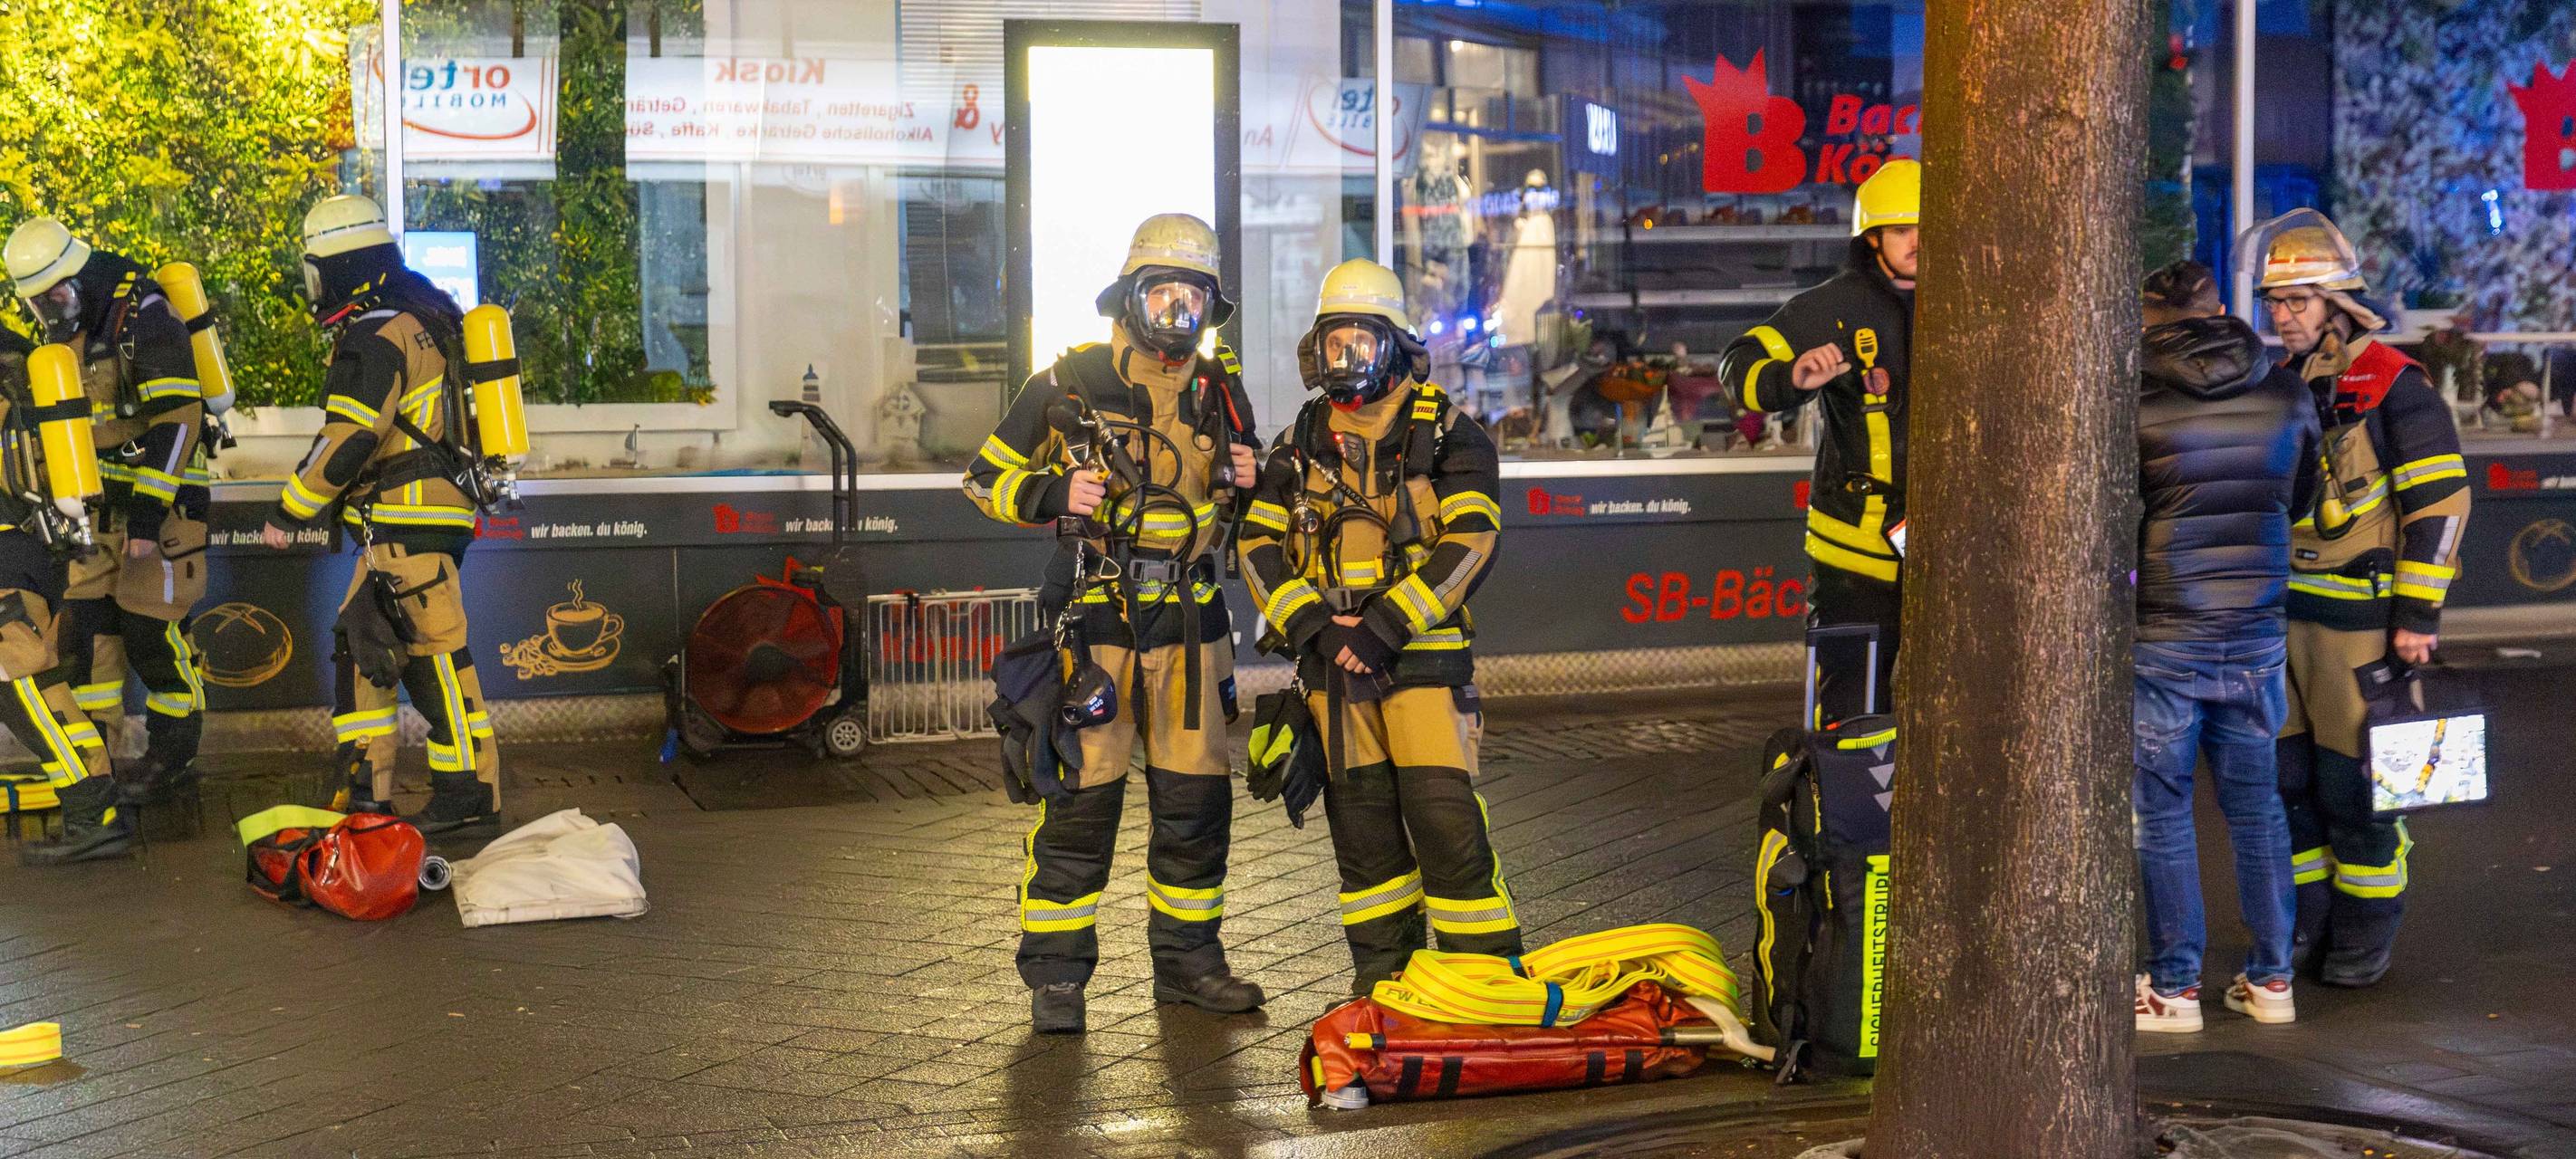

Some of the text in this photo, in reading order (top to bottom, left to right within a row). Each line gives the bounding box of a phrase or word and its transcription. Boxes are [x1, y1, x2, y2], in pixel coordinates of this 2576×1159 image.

[1825, 93, 1922, 135] Bac
[1814, 142, 1913, 185] Kö
[1590, 500, 1608, 515] wir
[1608, 500, 1645, 515] backen.
[1646, 499, 1660, 513] du
[1661, 498, 1693, 515] könig.
[531, 522, 550, 539] wir
[551, 522, 594, 539] backen.
[596, 522, 611, 537] du
[612, 520, 649, 538] könig.
[785, 517, 803, 533] wir
[864, 516, 899, 533] könig.
[210, 529, 229, 546] wir
[231, 528, 266, 545] back
[284, 530, 295, 544] u
[1620, 566, 1811, 624] SB-Bäc
